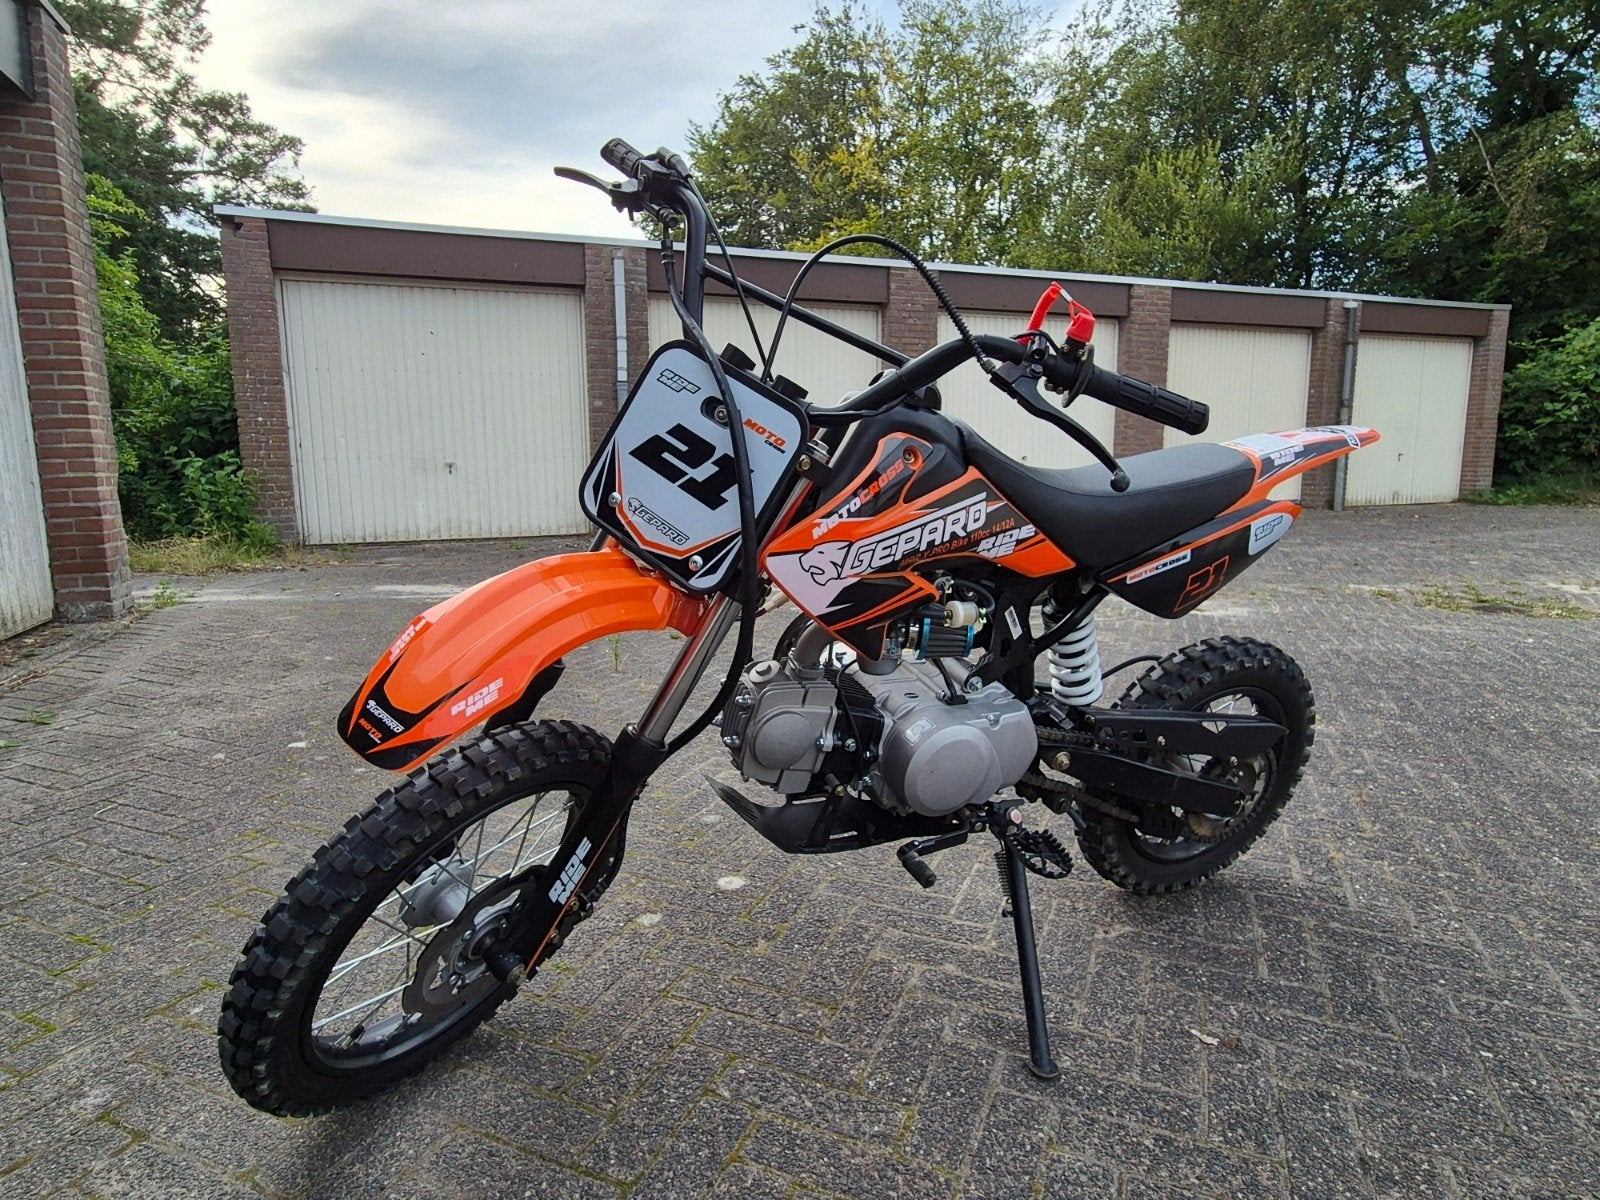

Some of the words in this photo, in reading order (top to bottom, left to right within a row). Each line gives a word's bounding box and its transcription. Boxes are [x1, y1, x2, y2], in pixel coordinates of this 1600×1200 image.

[656, 374, 685, 393] ME
[660, 368, 702, 395] RIDE
[742, 418, 786, 447] MOTO
[628, 423, 755, 511] 21
[633, 505, 690, 546] GEPARD
[840, 491, 987, 579] GEPARD
[950, 537, 969, 550] Bike
[970, 529, 990, 543] 110cc
[976, 524, 1036, 553] RIDE
[1128, 554, 1188, 581] MOTOCROSS
[451, 677, 504, 716] RIDE
[465, 690, 499, 717] ME
[358, 718, 382, 739] MOTO
[369, 705, 405, 733] GEPARD
[548, 836, 592, 903] RIDE
[557, 863, 587, 905] ME
